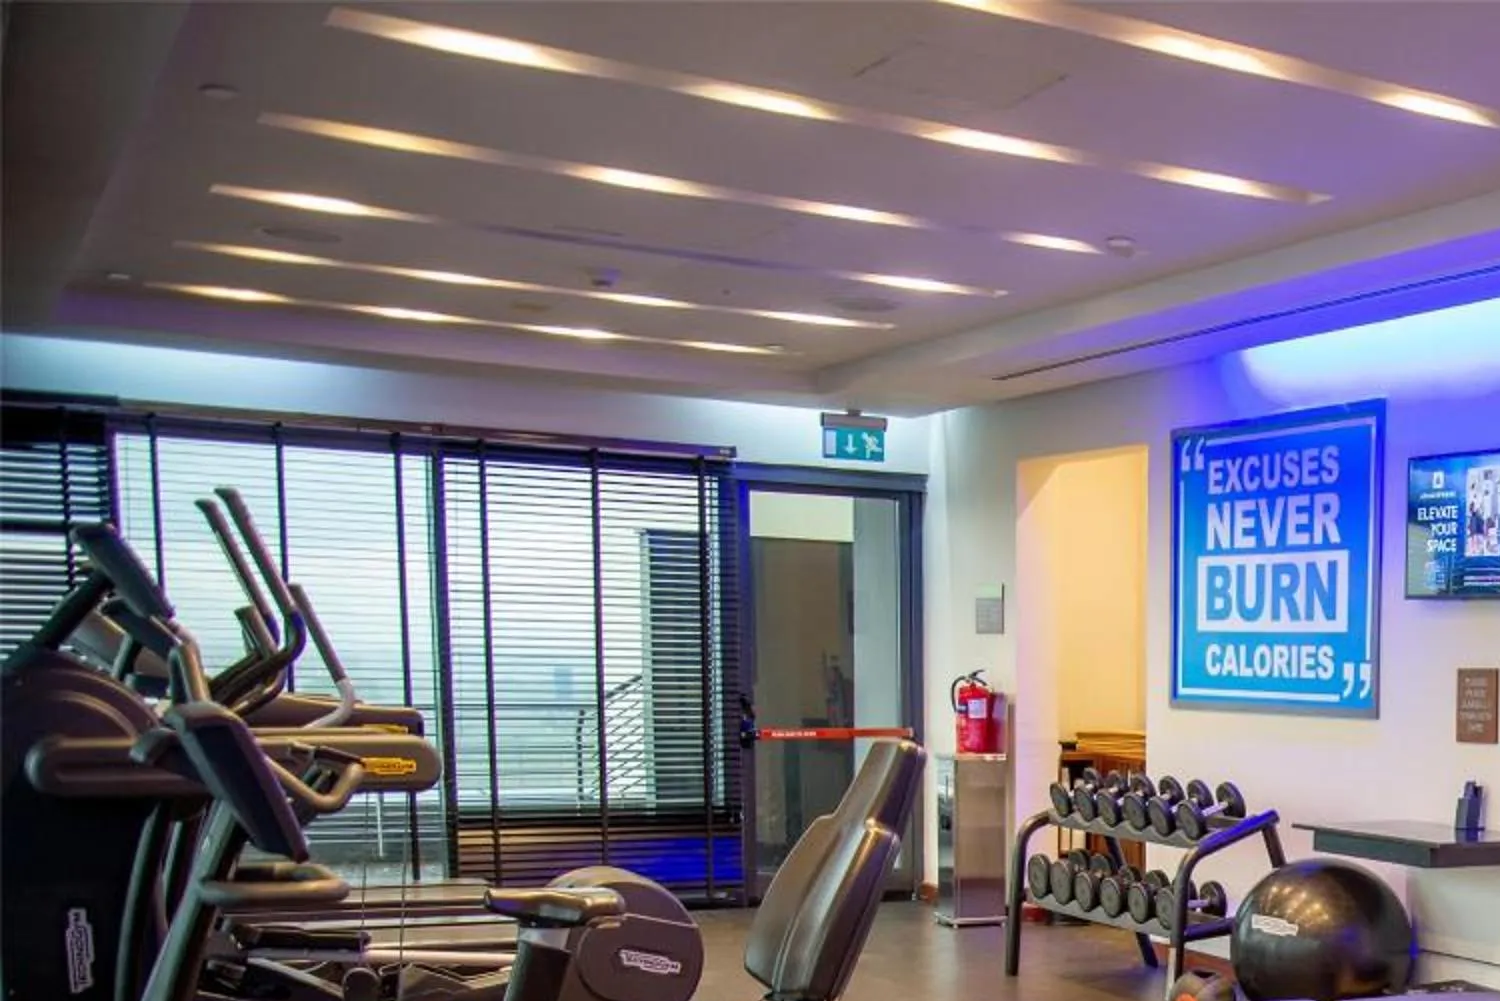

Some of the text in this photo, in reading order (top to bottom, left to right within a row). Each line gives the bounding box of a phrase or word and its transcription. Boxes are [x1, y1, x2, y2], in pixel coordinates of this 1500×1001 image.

[1208, 445, 1340, 494] EXCUSES
[1206, 492, 1341, 551] NEVER
[1417, 505, 1458, 520] ELEVATE
[1431, 521, 1457, 537] YOUR
[1427, 538, 1457, 552] SPACE
[1206, 560, 1338, 622] BURN
[1206, 643, 1335, 680] CALORIES
